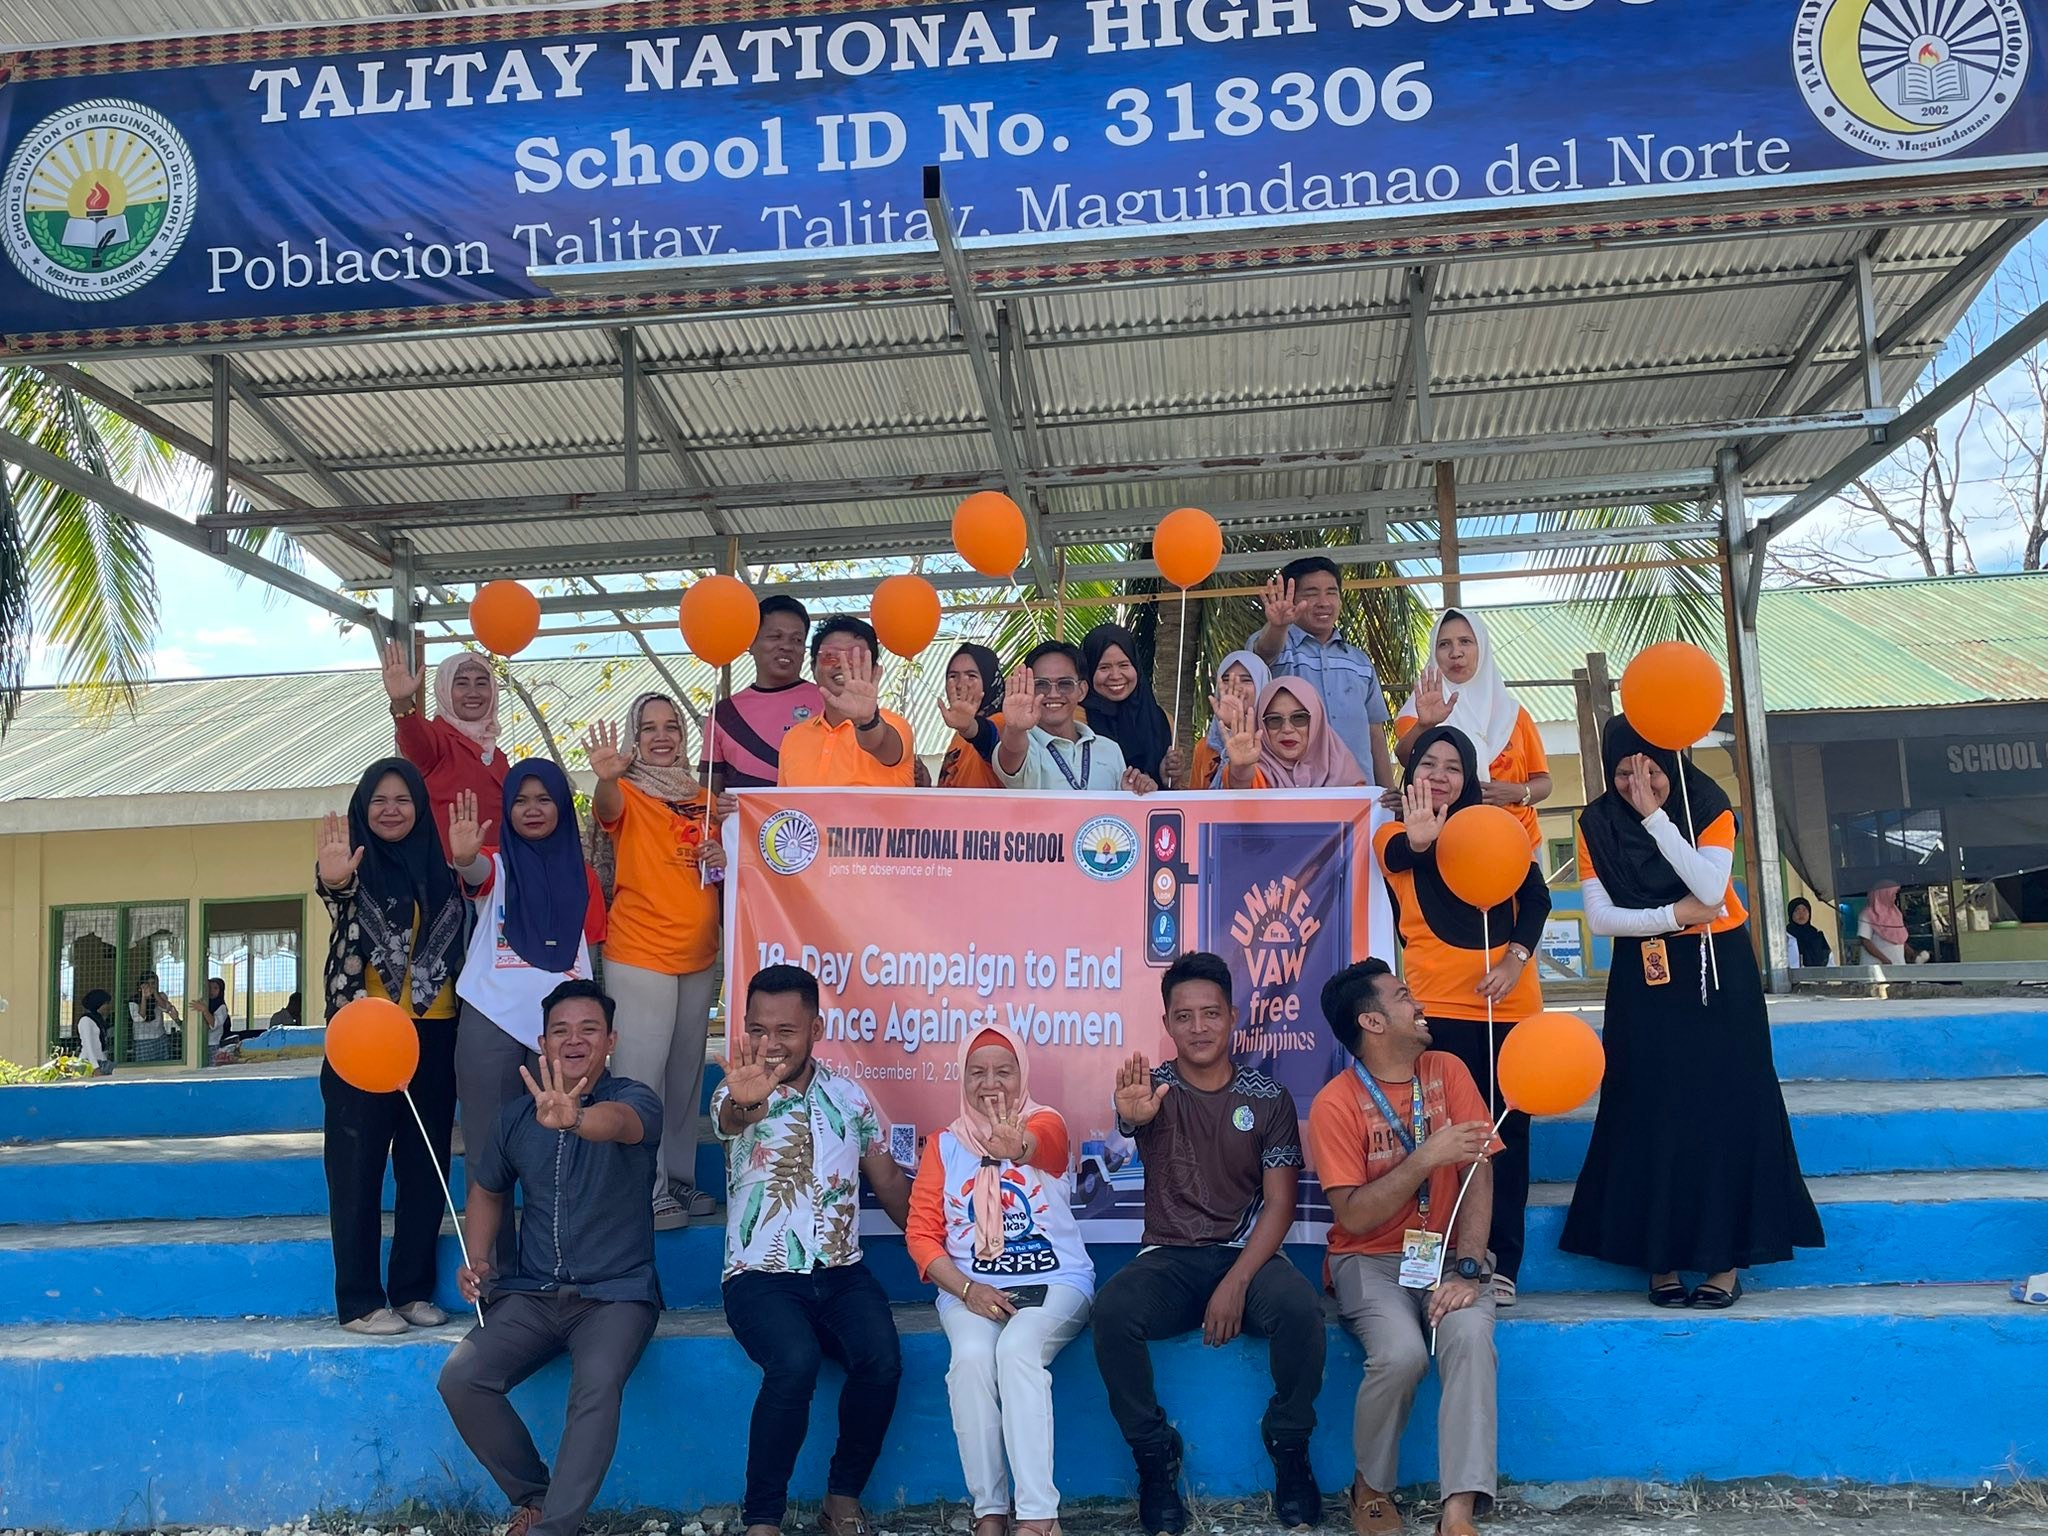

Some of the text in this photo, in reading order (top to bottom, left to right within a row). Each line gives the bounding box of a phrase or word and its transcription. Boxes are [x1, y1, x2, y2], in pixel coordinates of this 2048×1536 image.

[249, 0, 1317, 123] TALITAY NATIONAL HIGH
[515, 61, 1433, 195] School ID No. 318306
[1921, 105, 1949, 117] 2002
[10, 113, 182, 250] SCHOOLS DIVISION OF MAGUINDANAO DEL NORTE
[206, 232, 494, 294] Poblacion
[1016, 162, 1460, 233] Maguindanao
[1485, 139, 1583, 196] del
[1607, 130, 1792, 187] Norte
[45, 265, 89, 288] MBHTE
[100, 260, 147, 287] BARMM
[1947, 741, 2042, 773] SCHOOL
[827, 827, 883, 857] TALITAY
[886, 828, 958, 860] NATIONAL
[962, 830, 1000, 861] HIGH
[1004, 831, 1065, 863] SCHOOL
[852, 863, 867, 875] the
[869, 864, 922, 876] observance
[924, 864, 935, 876] of
[937, 865, 953, 877] the
[860, 942, 1016, 996] Campaign
[1024, 950, 1056, 988] to
[1065, 946, 1122, 989] End
[1244, 946, 1308, 988] VAW
[884, 997, 997, 1052] Against
[1006, 1003, 1123, 1046] Women
[1250, 991, 1300, 1026] free
[1232, 1024, 1315, 1059] Philippines
[855, 1061, 917, 1081] December
[922, 1062, 938, 1082] 12,
